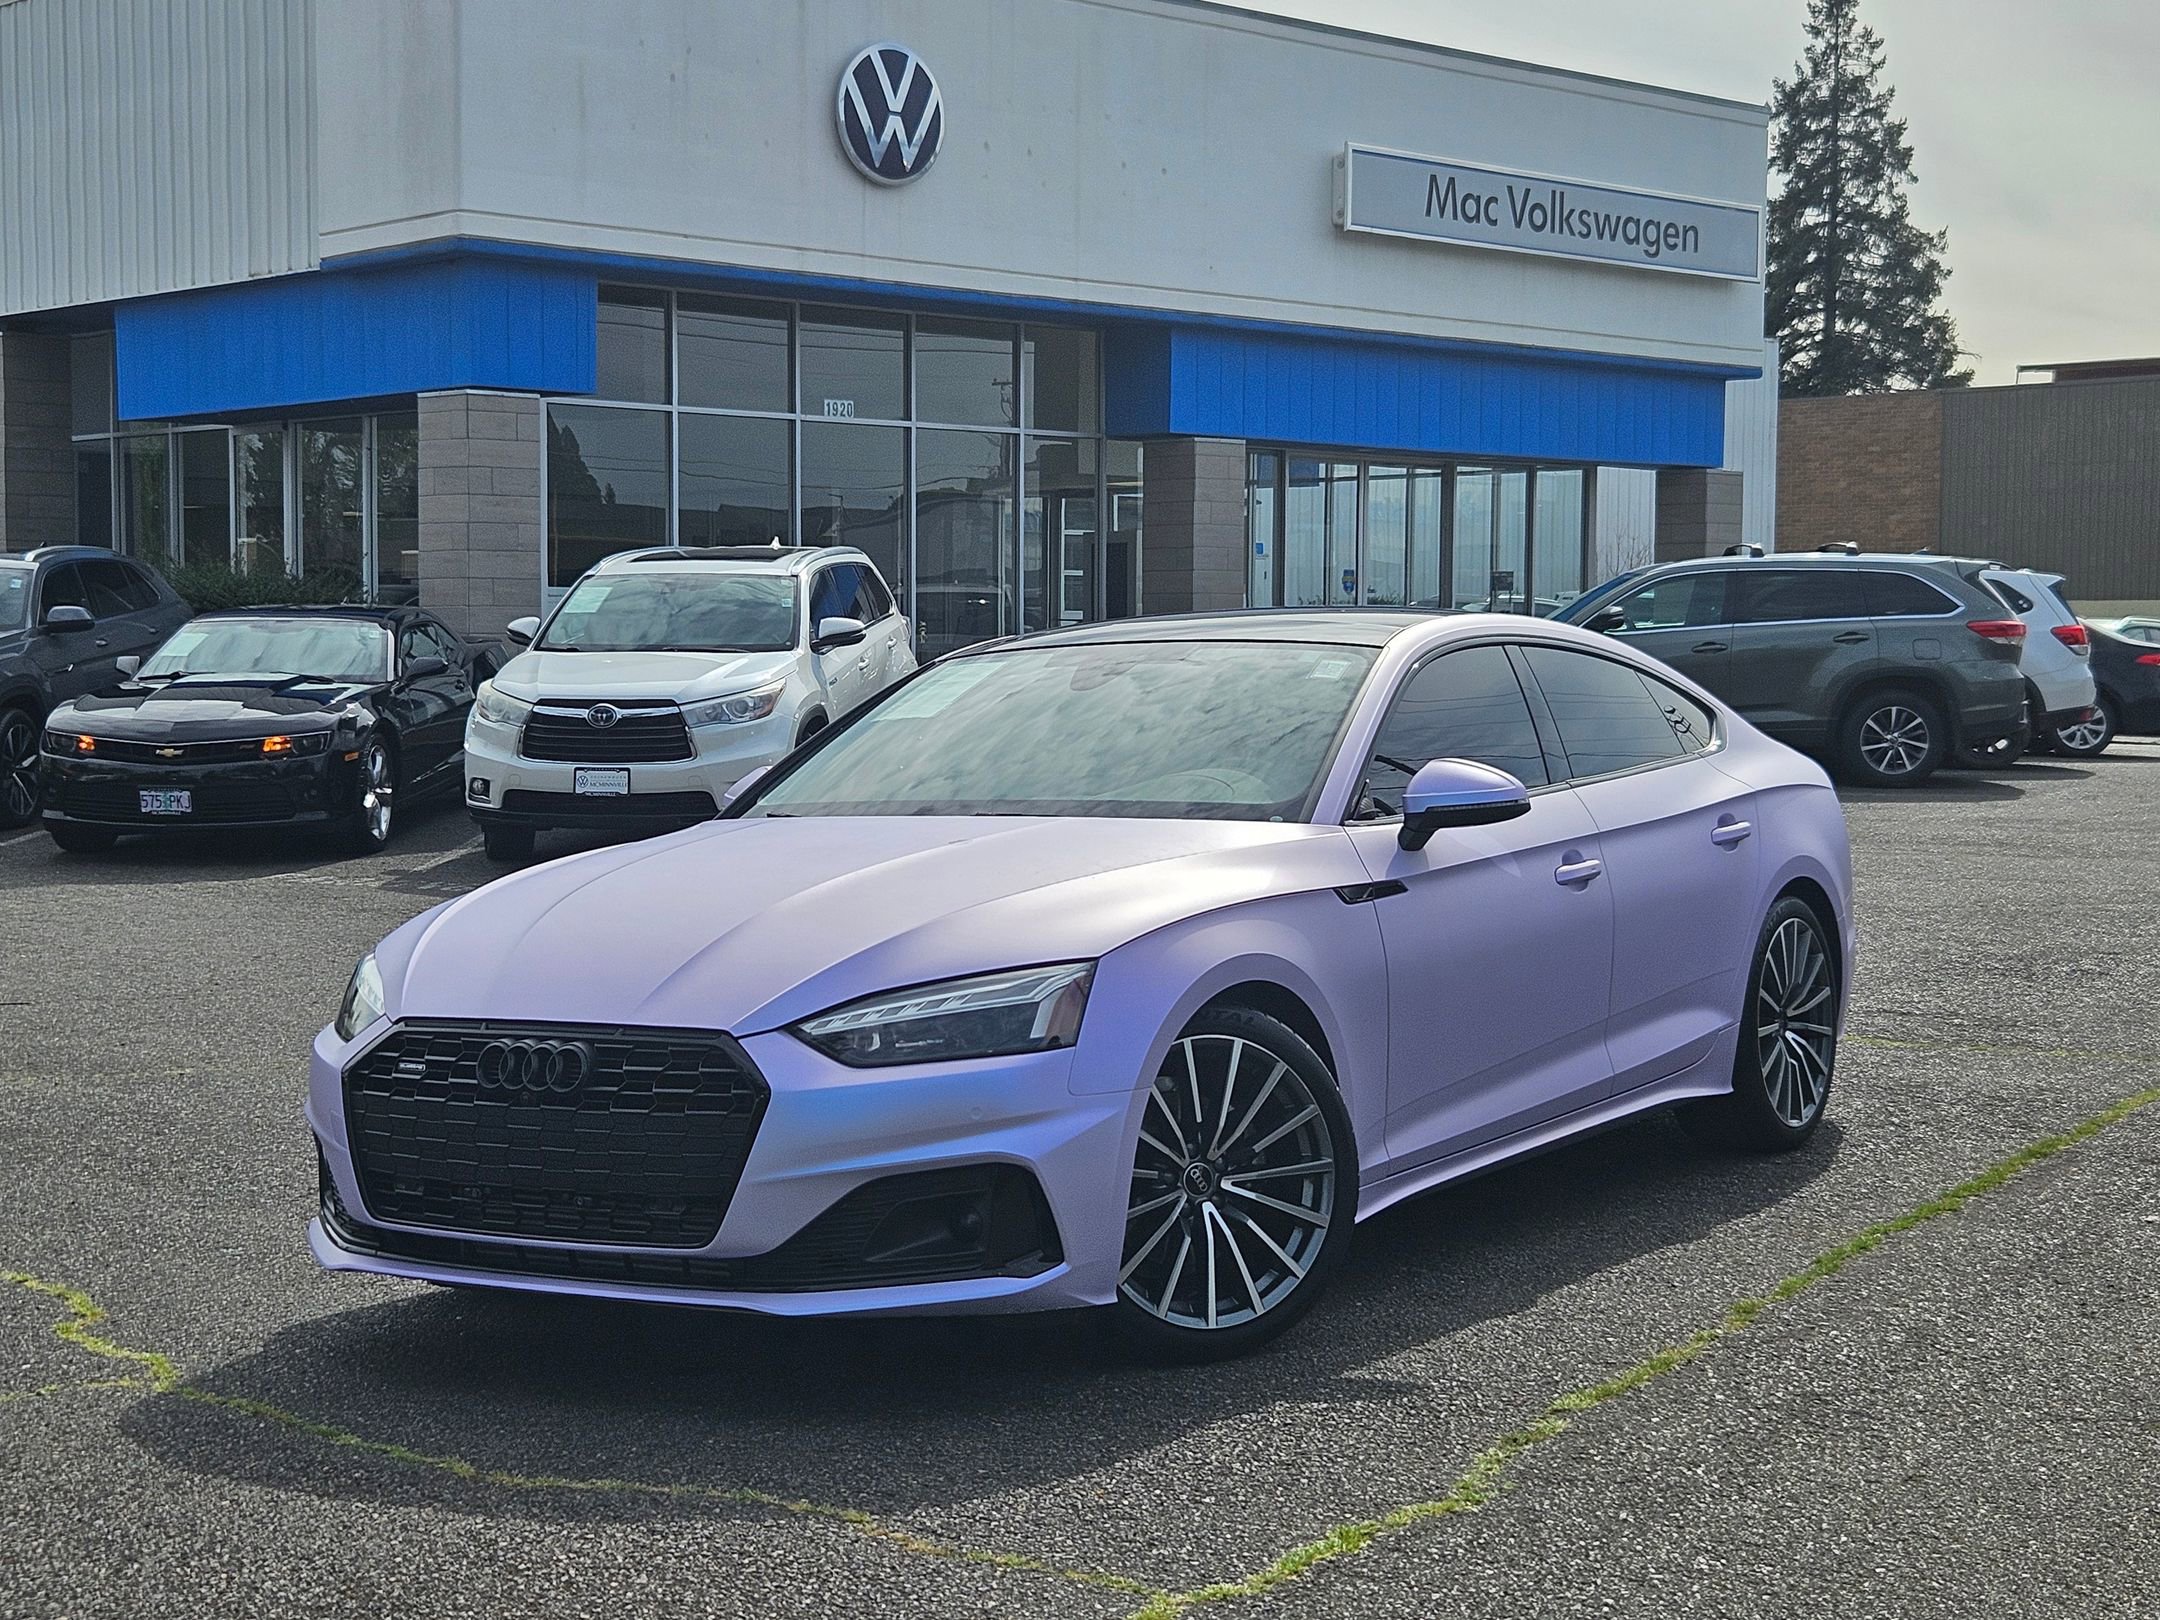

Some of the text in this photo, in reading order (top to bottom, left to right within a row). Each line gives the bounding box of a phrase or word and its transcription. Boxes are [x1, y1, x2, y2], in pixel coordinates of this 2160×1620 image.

[841, 44, 943, 180] VW
[1425, 174, 1699, 258] Mac Volkswagen
[826, 401, 853, 418] 1920
[141, 794, 191, 809] 575 PKJ
